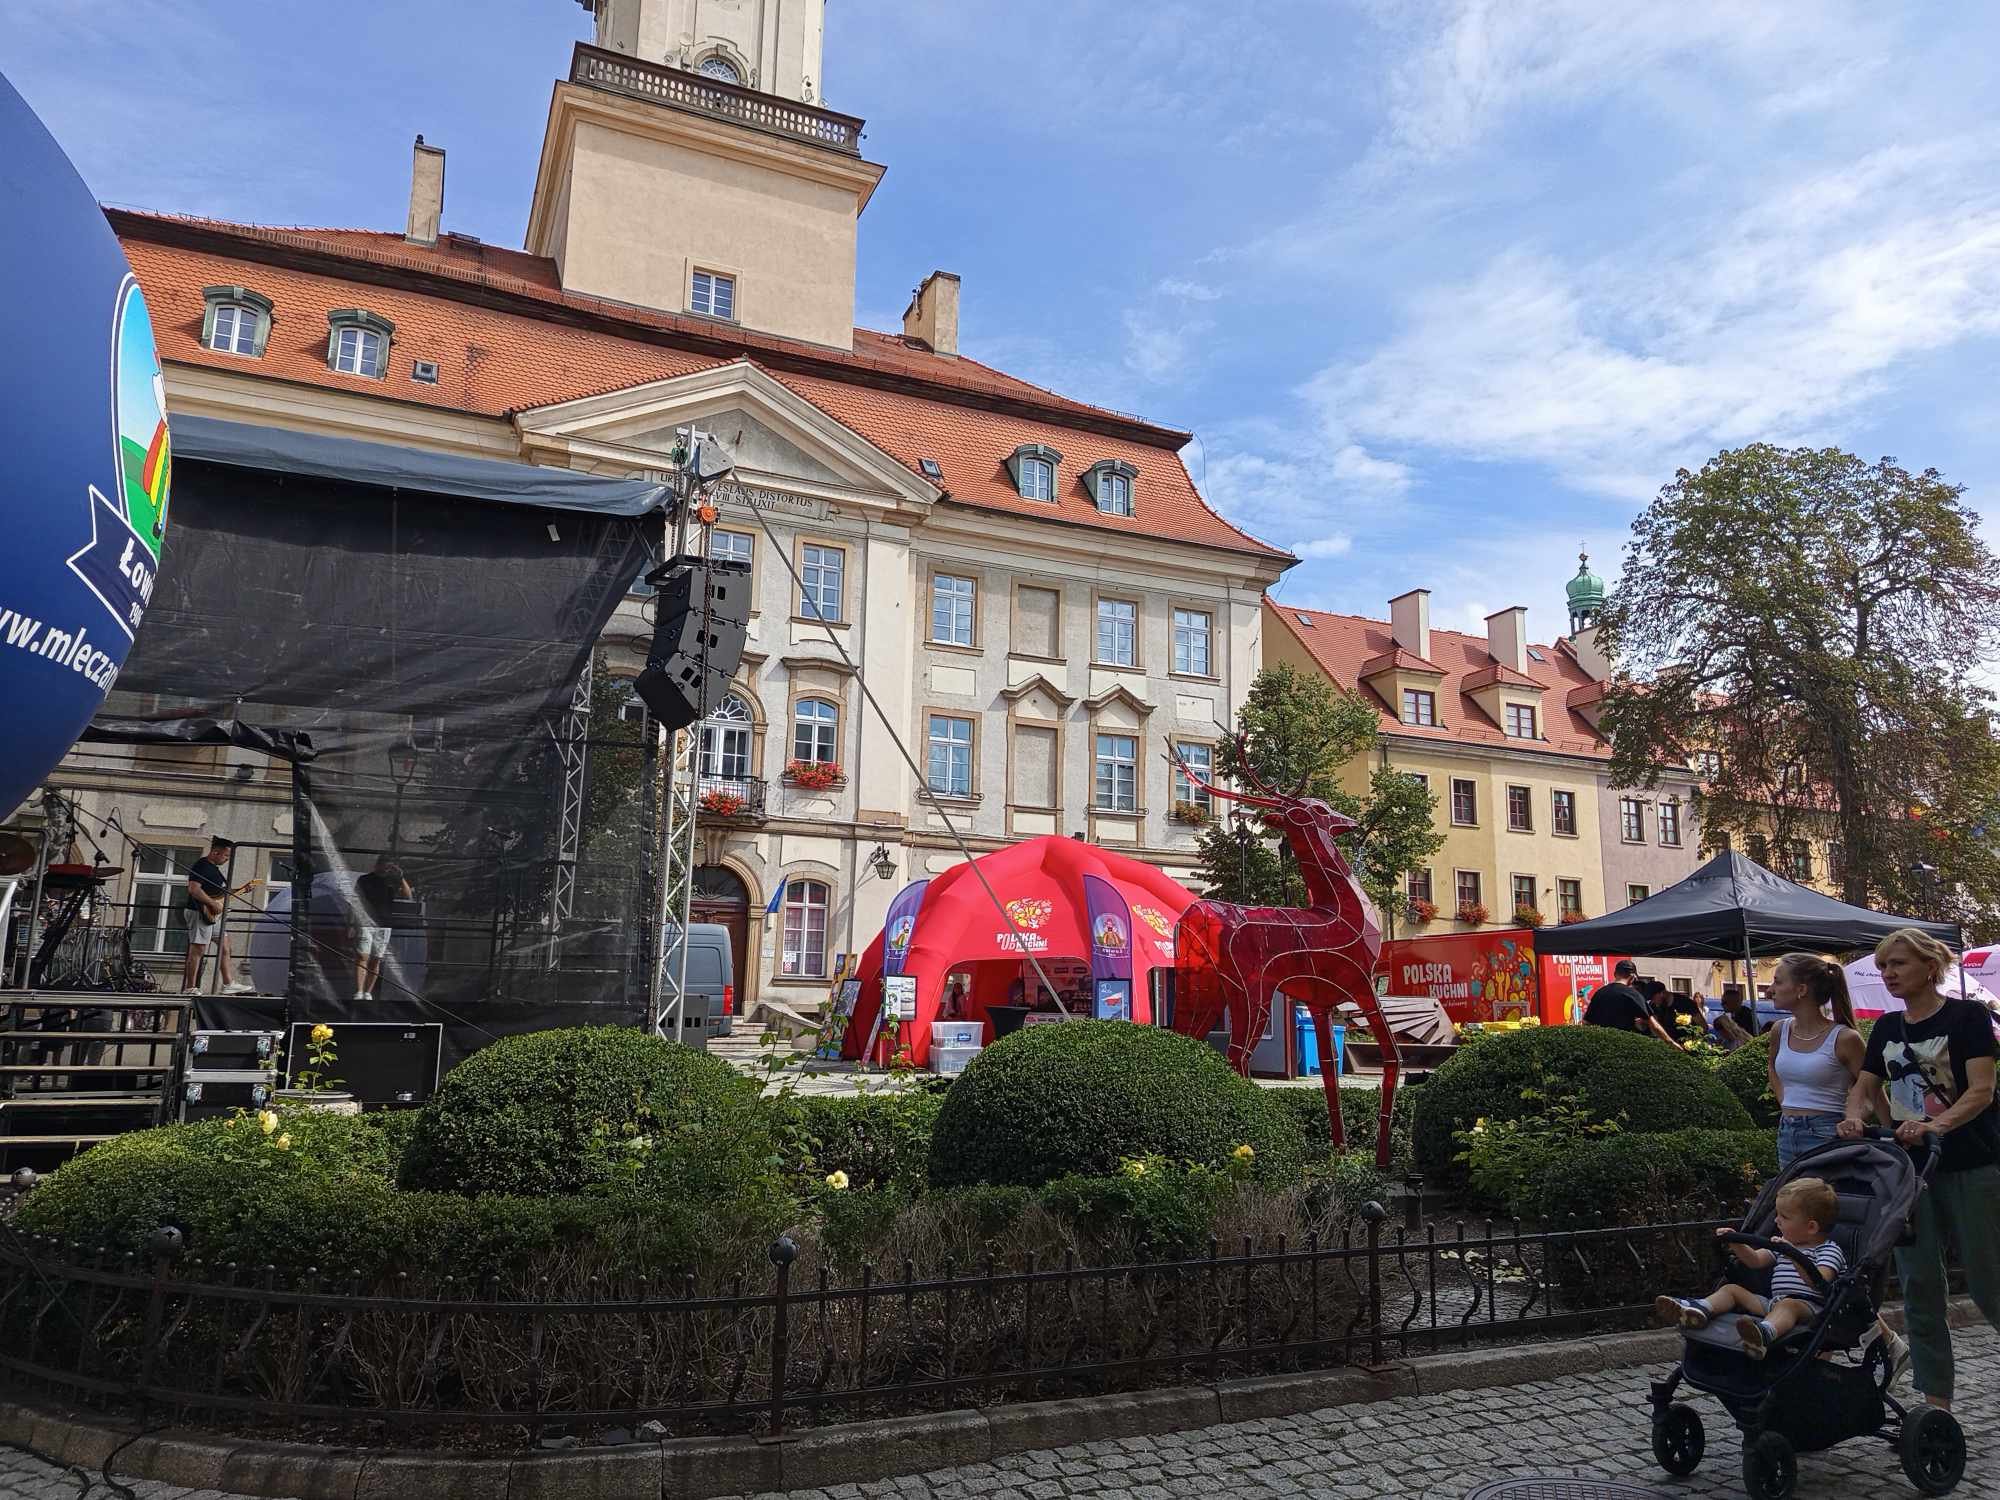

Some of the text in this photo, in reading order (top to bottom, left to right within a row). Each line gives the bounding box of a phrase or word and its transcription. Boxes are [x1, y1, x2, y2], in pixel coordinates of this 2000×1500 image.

[759, 489, 813, 508] DISTORTUS
[1402, 962, 1453, 985] POLSKA
[1557, 964, 1603, 977] OD KUCHNI
[1428, 982, 1469, 1000] KUCHNI
